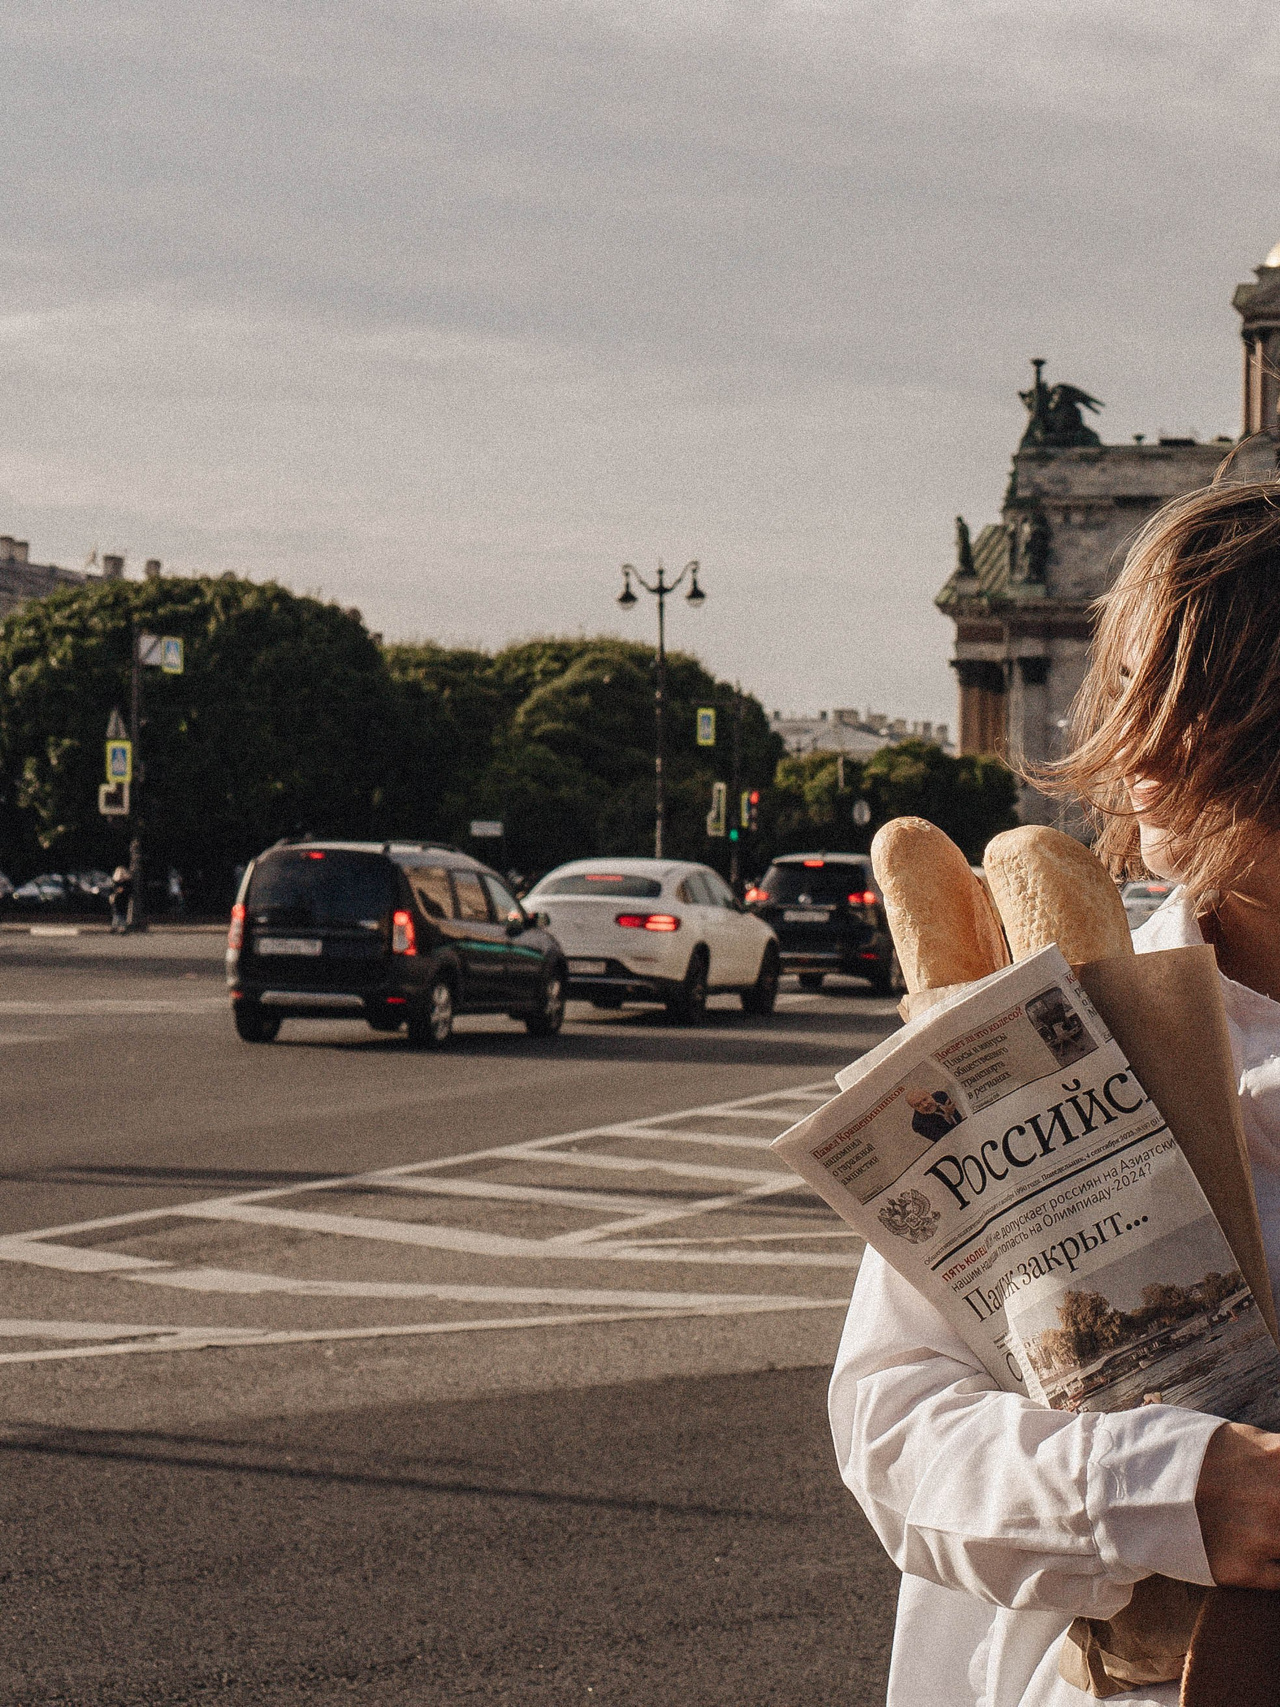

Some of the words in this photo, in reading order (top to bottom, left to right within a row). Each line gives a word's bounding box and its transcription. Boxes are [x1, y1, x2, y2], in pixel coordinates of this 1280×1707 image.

[989, 1007, 1023, 1033] колесо?
[812, 1138, 841, 1160] Павел
[837, 1086, 906, 1142] Крашенинников
[823, 1139, 863, 1169] напомнил
[924, 1066, 1153, 1211] Российс
[942, 1263, 966, 1282] ПЯТЬ
[1001, 1202, 1048, 1238] допускает
[1049, 1175, 1102, 1211] россиян
[1102, 1168, 1119, 1182] на
[952, 1267, 982, 1293] нашим
[1029, 1222, 1044, 1236] на
[1042, 1162, 1152, 1227] Олимпиаду-2024?
[1016, 1211, 1149, 1286] закрыт...
